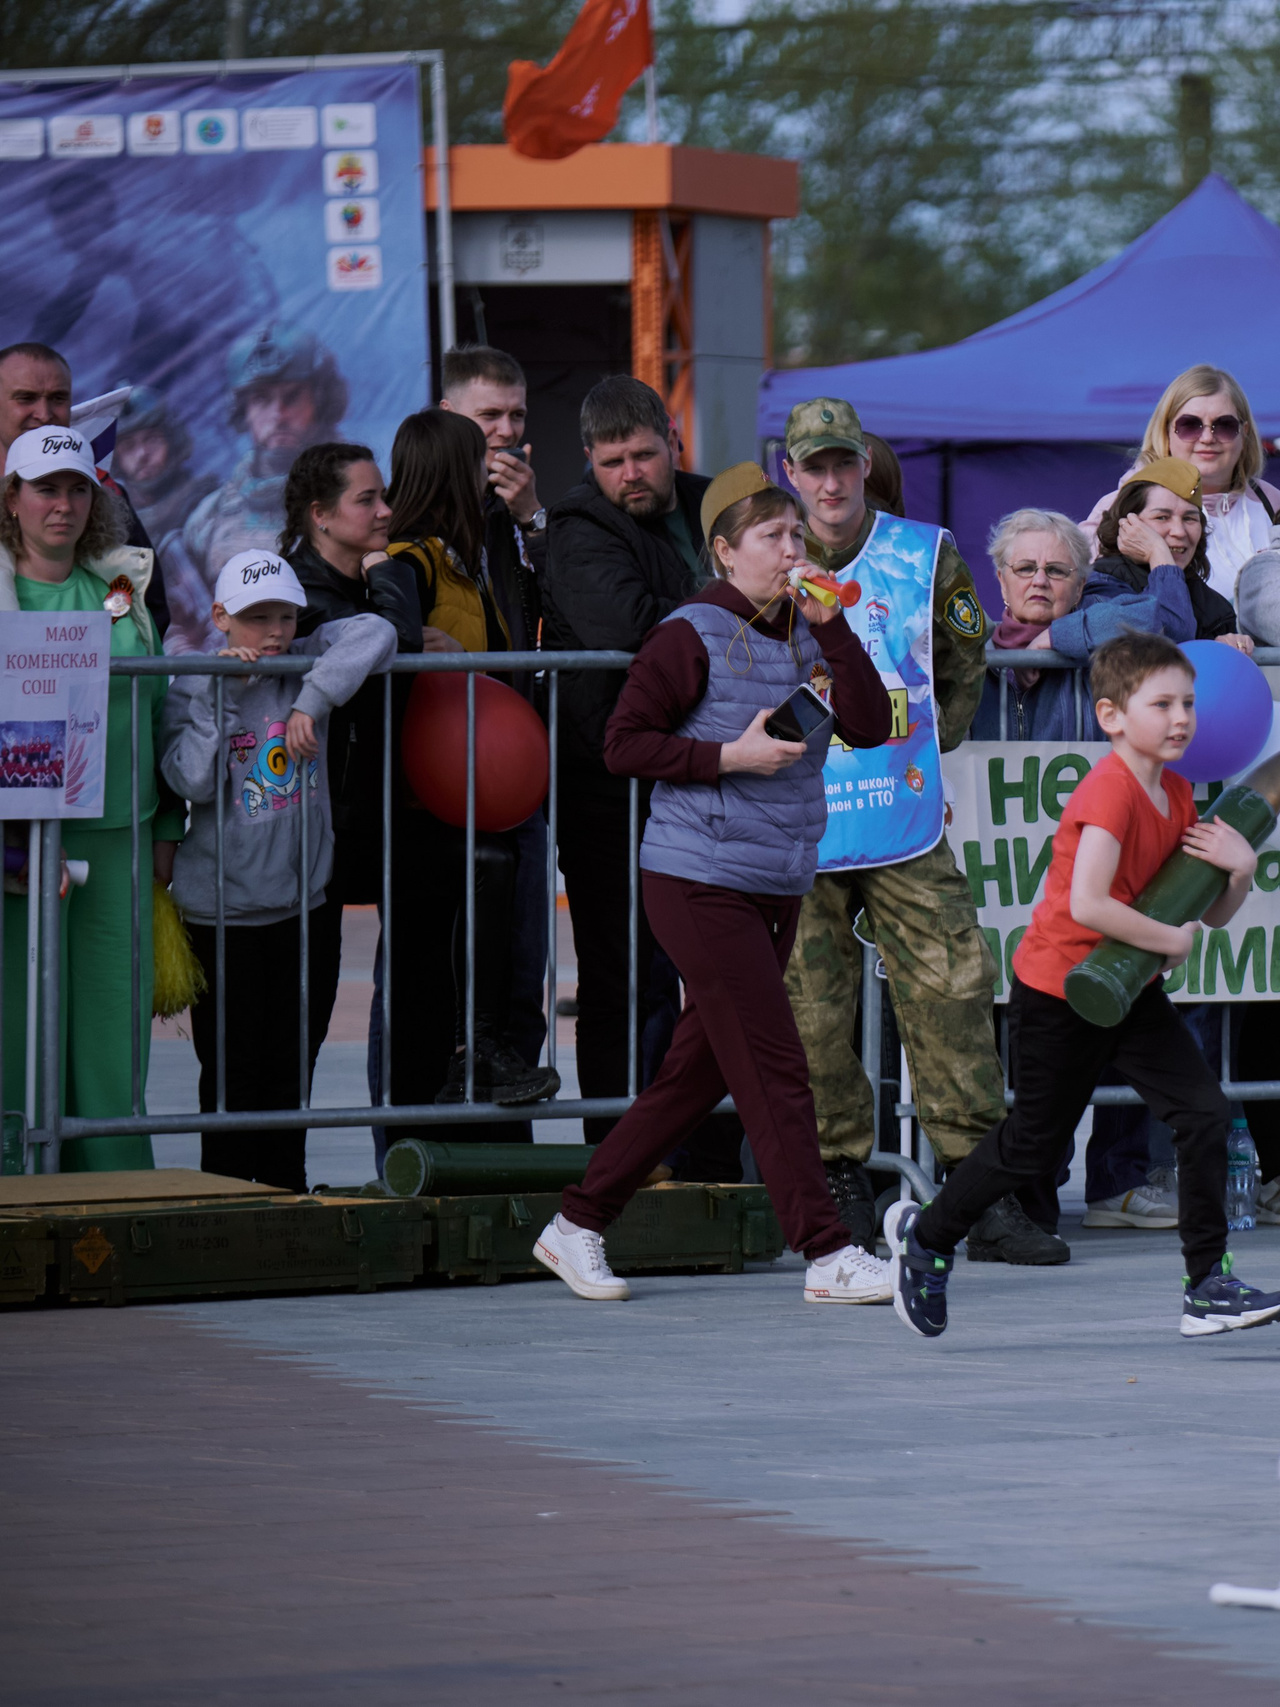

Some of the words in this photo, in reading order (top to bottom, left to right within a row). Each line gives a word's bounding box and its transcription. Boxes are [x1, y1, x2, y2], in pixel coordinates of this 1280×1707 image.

[45, 625, 88, 643] МАОУ
[6, 652, 98, 670] КОМЕНСКАЯ
[21, 679, 57, 695] СОШ
[868, 789, 894, 808] ГТО
